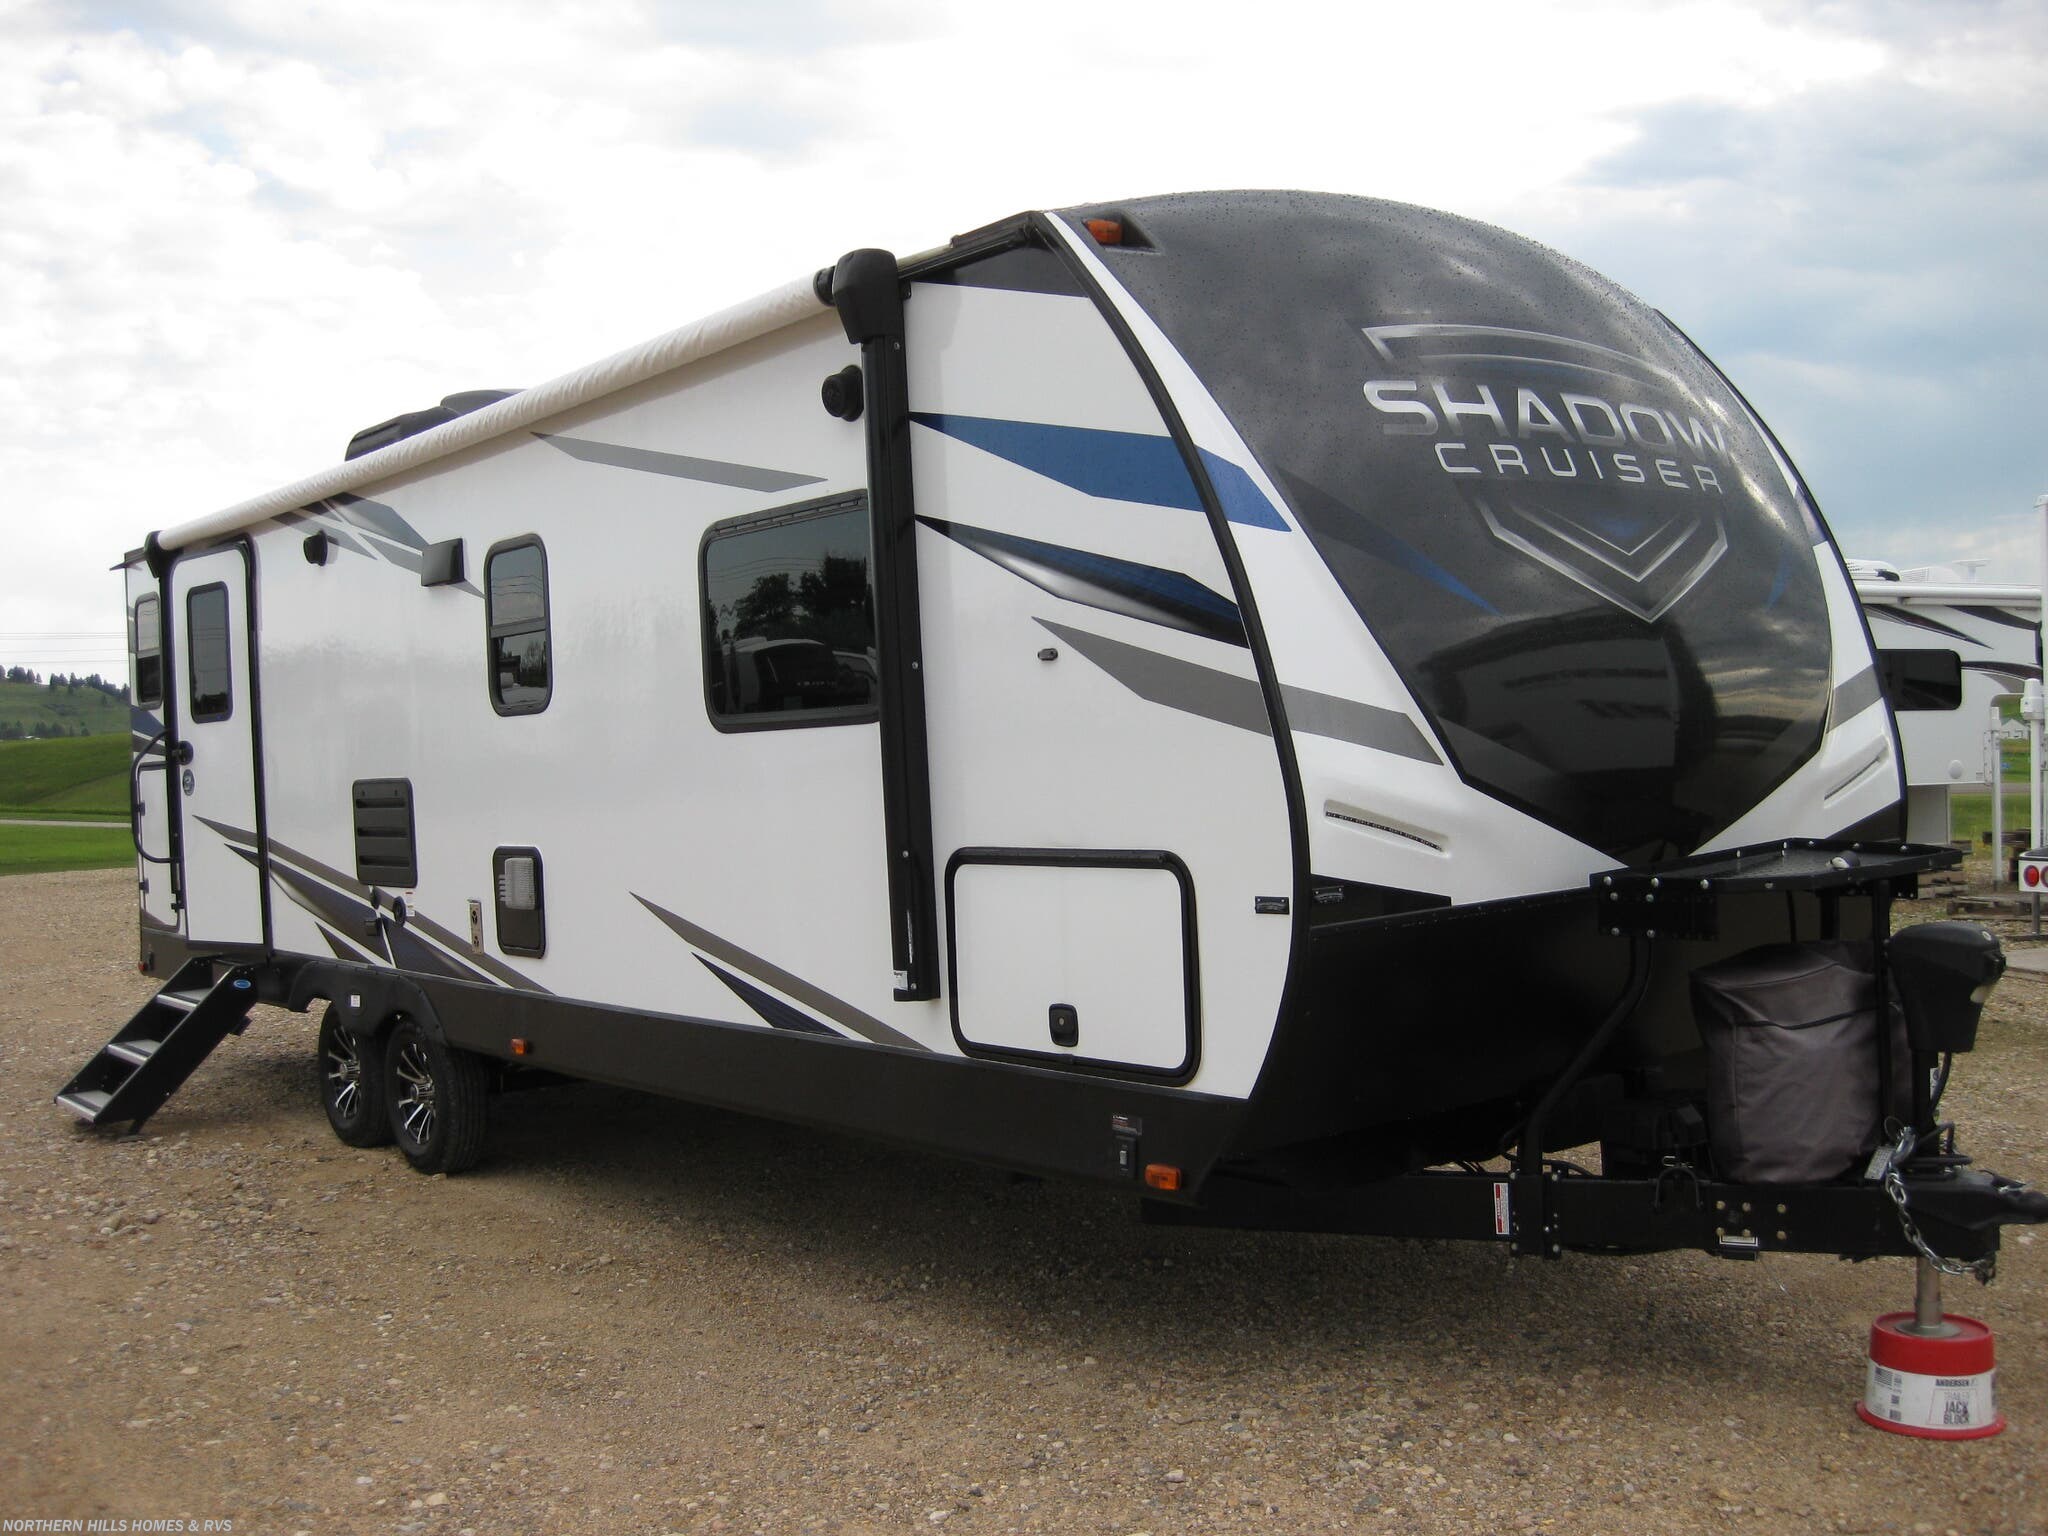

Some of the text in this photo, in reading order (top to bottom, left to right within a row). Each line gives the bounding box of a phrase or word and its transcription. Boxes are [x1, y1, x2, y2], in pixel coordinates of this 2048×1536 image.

[1363, 380, 1728, 461] SHADOW
[1434, 442, 1723, 495] CRUISER
[1944, 1401, 1969, 1414] JACK
[1944, 1414, 1969, 1424] BLOCK
